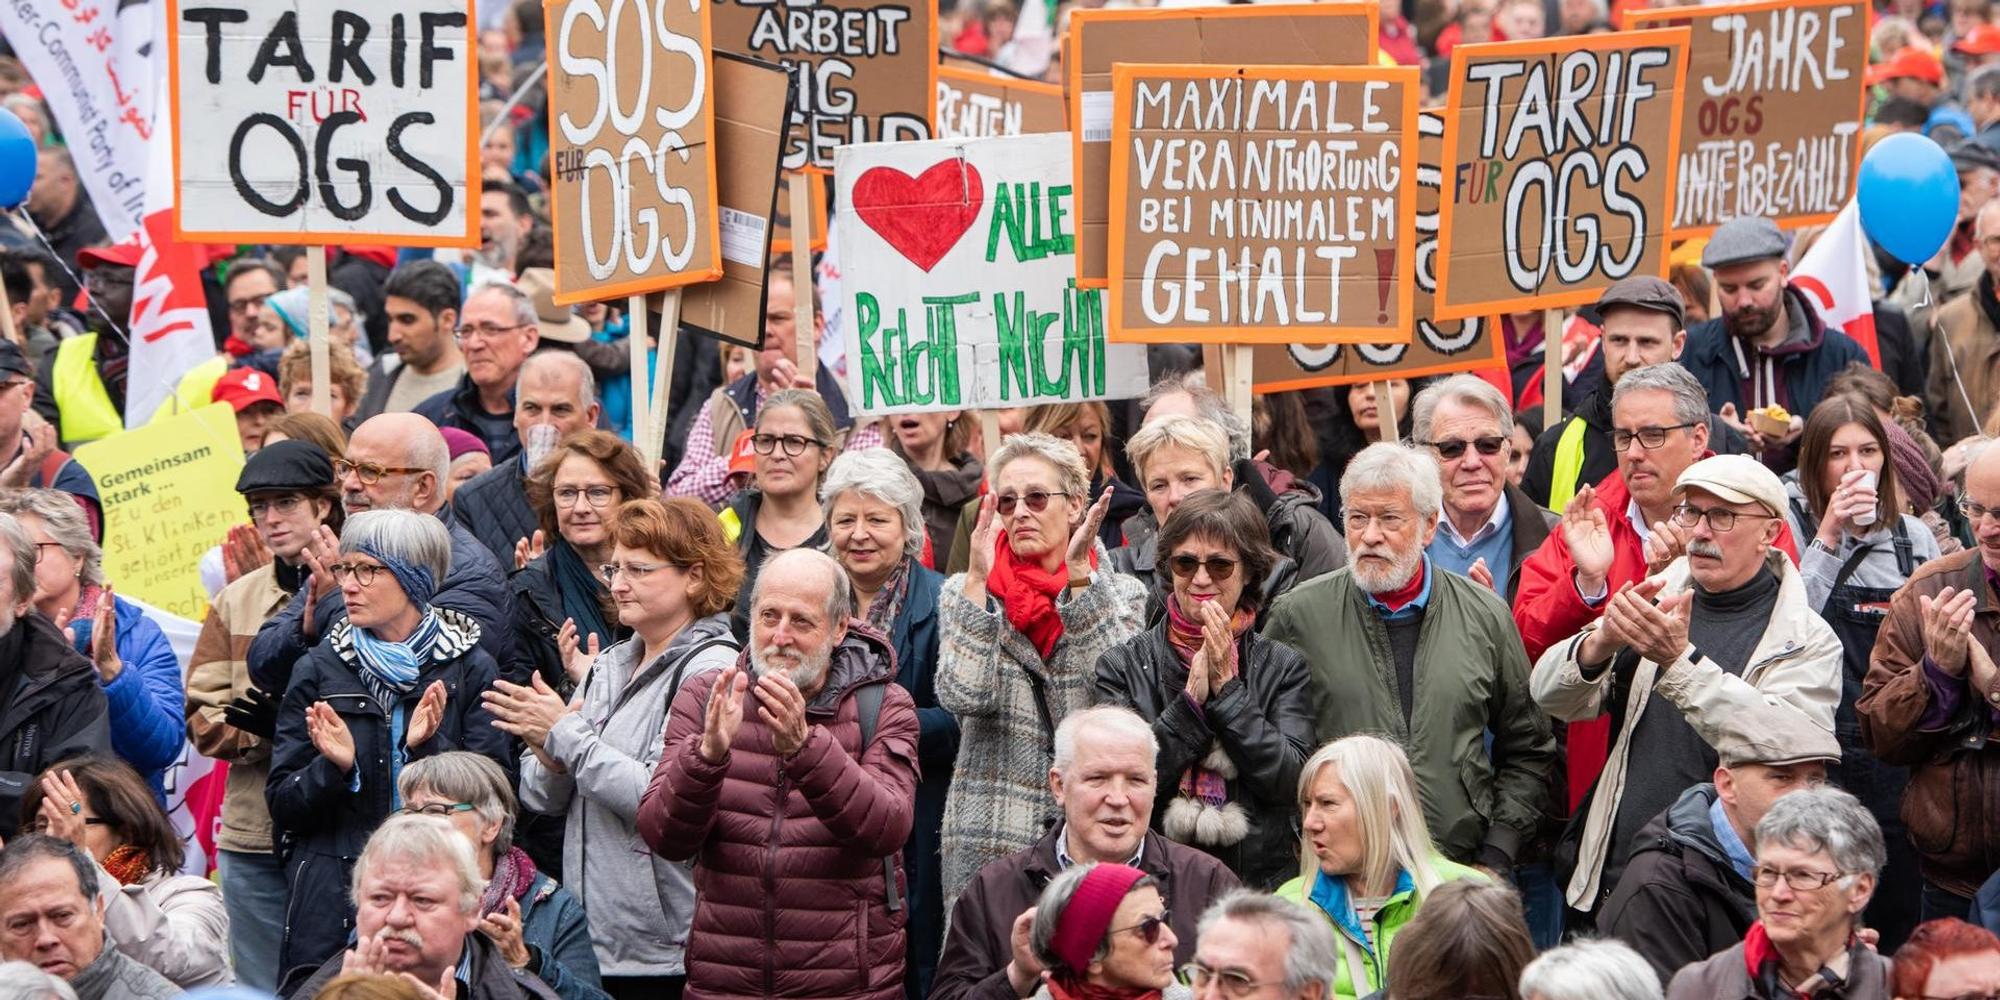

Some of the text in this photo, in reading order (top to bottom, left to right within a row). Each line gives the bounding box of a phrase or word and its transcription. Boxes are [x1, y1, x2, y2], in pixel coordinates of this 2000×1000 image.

[183, 8, 468, 88] TARIF
[750, 7, 911, 56] ARBEIT
[1702, 6, 1853, 96] JAHRE
[287, 85, 368, 125] FÜR
[559, 0, 705, 145] SOS
[1134, 77, 1390, 133] MAXIMALE
[1467, 47, 1670, 161] TARIF
[1697, 94, 1764, 136] OGS
[86, 119, 115, 173] Party
[108, 171, 142, 194] of
[229, 112, 454, 226] OGS
[556, 146, 585, 182] FÜR
[581, 131, 696, 281] OGS
[1140, 196, 1394, 241] BEI MINIMALEM
[1504, 147, 1650, 292] OGS
[1141, 239, 1357, 326] GEHALT
[856, 290, 981, 410] REICHT
[100, 446, 211, 489] Gemeinsam
[104, 482, 151, 508] stark
[152, 492, 182, 514] den
